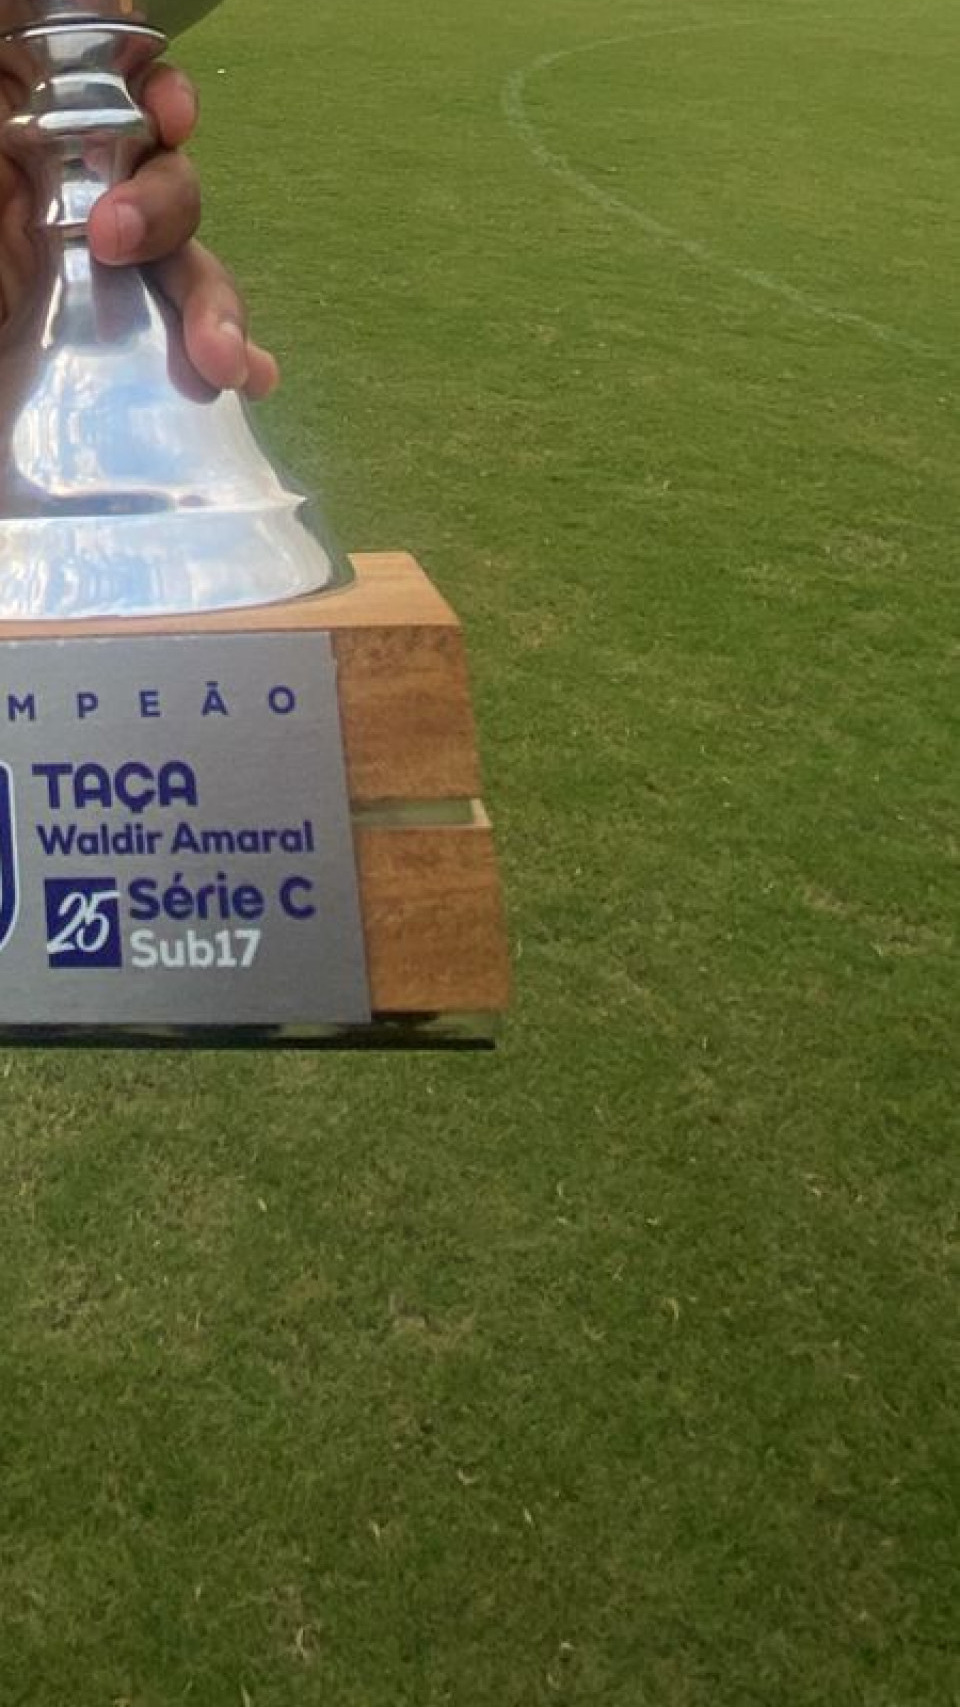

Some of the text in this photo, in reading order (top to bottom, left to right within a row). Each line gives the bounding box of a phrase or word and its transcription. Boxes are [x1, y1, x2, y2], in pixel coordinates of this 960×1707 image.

[32, 761, 199, 813] TAÇA
[36, 821, 315, 856] Waldir Amaral
[129, 872, 317, 921] Série C
[46, 891, 120, 954] 25
[129, 930, 262, 968] Sub17
